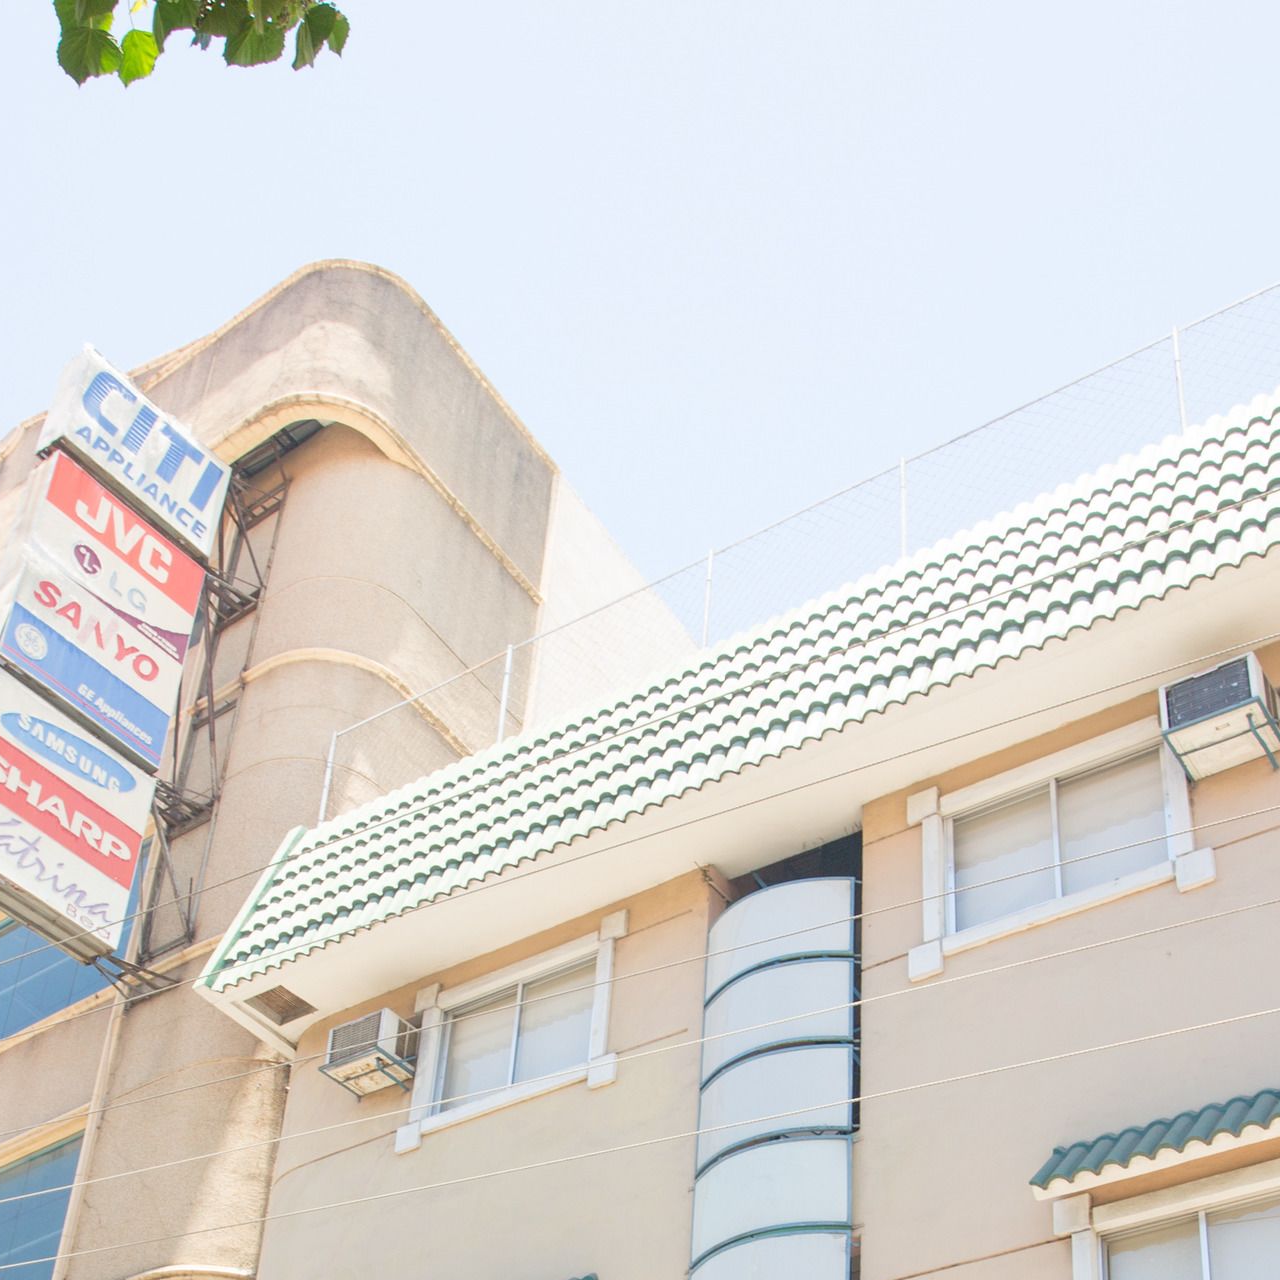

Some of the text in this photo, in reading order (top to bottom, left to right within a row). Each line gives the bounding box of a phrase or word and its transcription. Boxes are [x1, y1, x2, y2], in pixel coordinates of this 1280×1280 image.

[75, 425, 208, 539] APPLIANCE
[82, 371, 224, 512] CITI
[74, 496, 174, 585] JVC
[33, 580, 160, 682] SANYO
[108, 570, 148, 614] LG
[17, 713, 121, 793] SAMSUNG
[77, 683, 153, 746] GE Appliances
